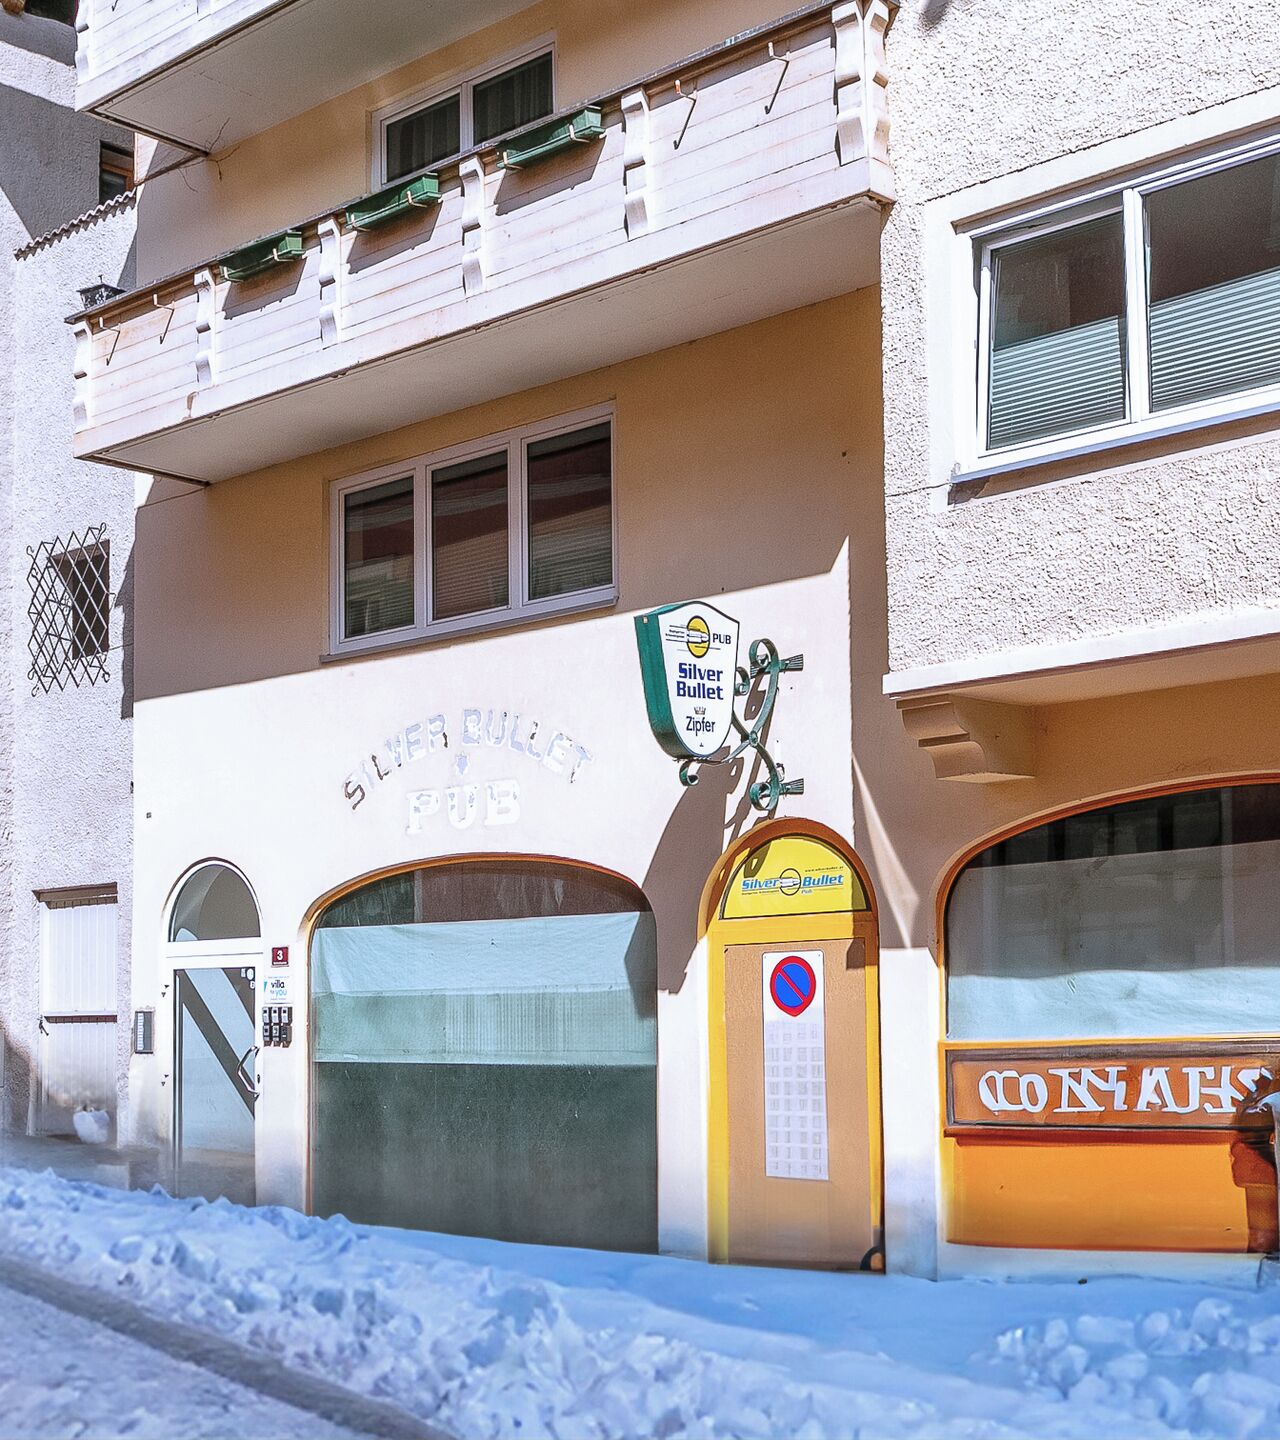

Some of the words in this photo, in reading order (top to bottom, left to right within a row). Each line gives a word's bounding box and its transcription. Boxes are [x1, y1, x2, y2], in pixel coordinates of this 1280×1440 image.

[712, 633, 732, 645] PUB
[678, 662, 724, 682] Silver
[676, 681, 724, 701] Bullet
[685, 715, 716, 737] Zipfer
[343, 712, 449, 811] SILVER
[461, 708, 594, 785] BULLET
[405, 778, 522, 835] PUB
[741, 879, 779, 889] Silver
[802, 874, 844, 887] Bullet
[276, 950, 283, 961] 3
